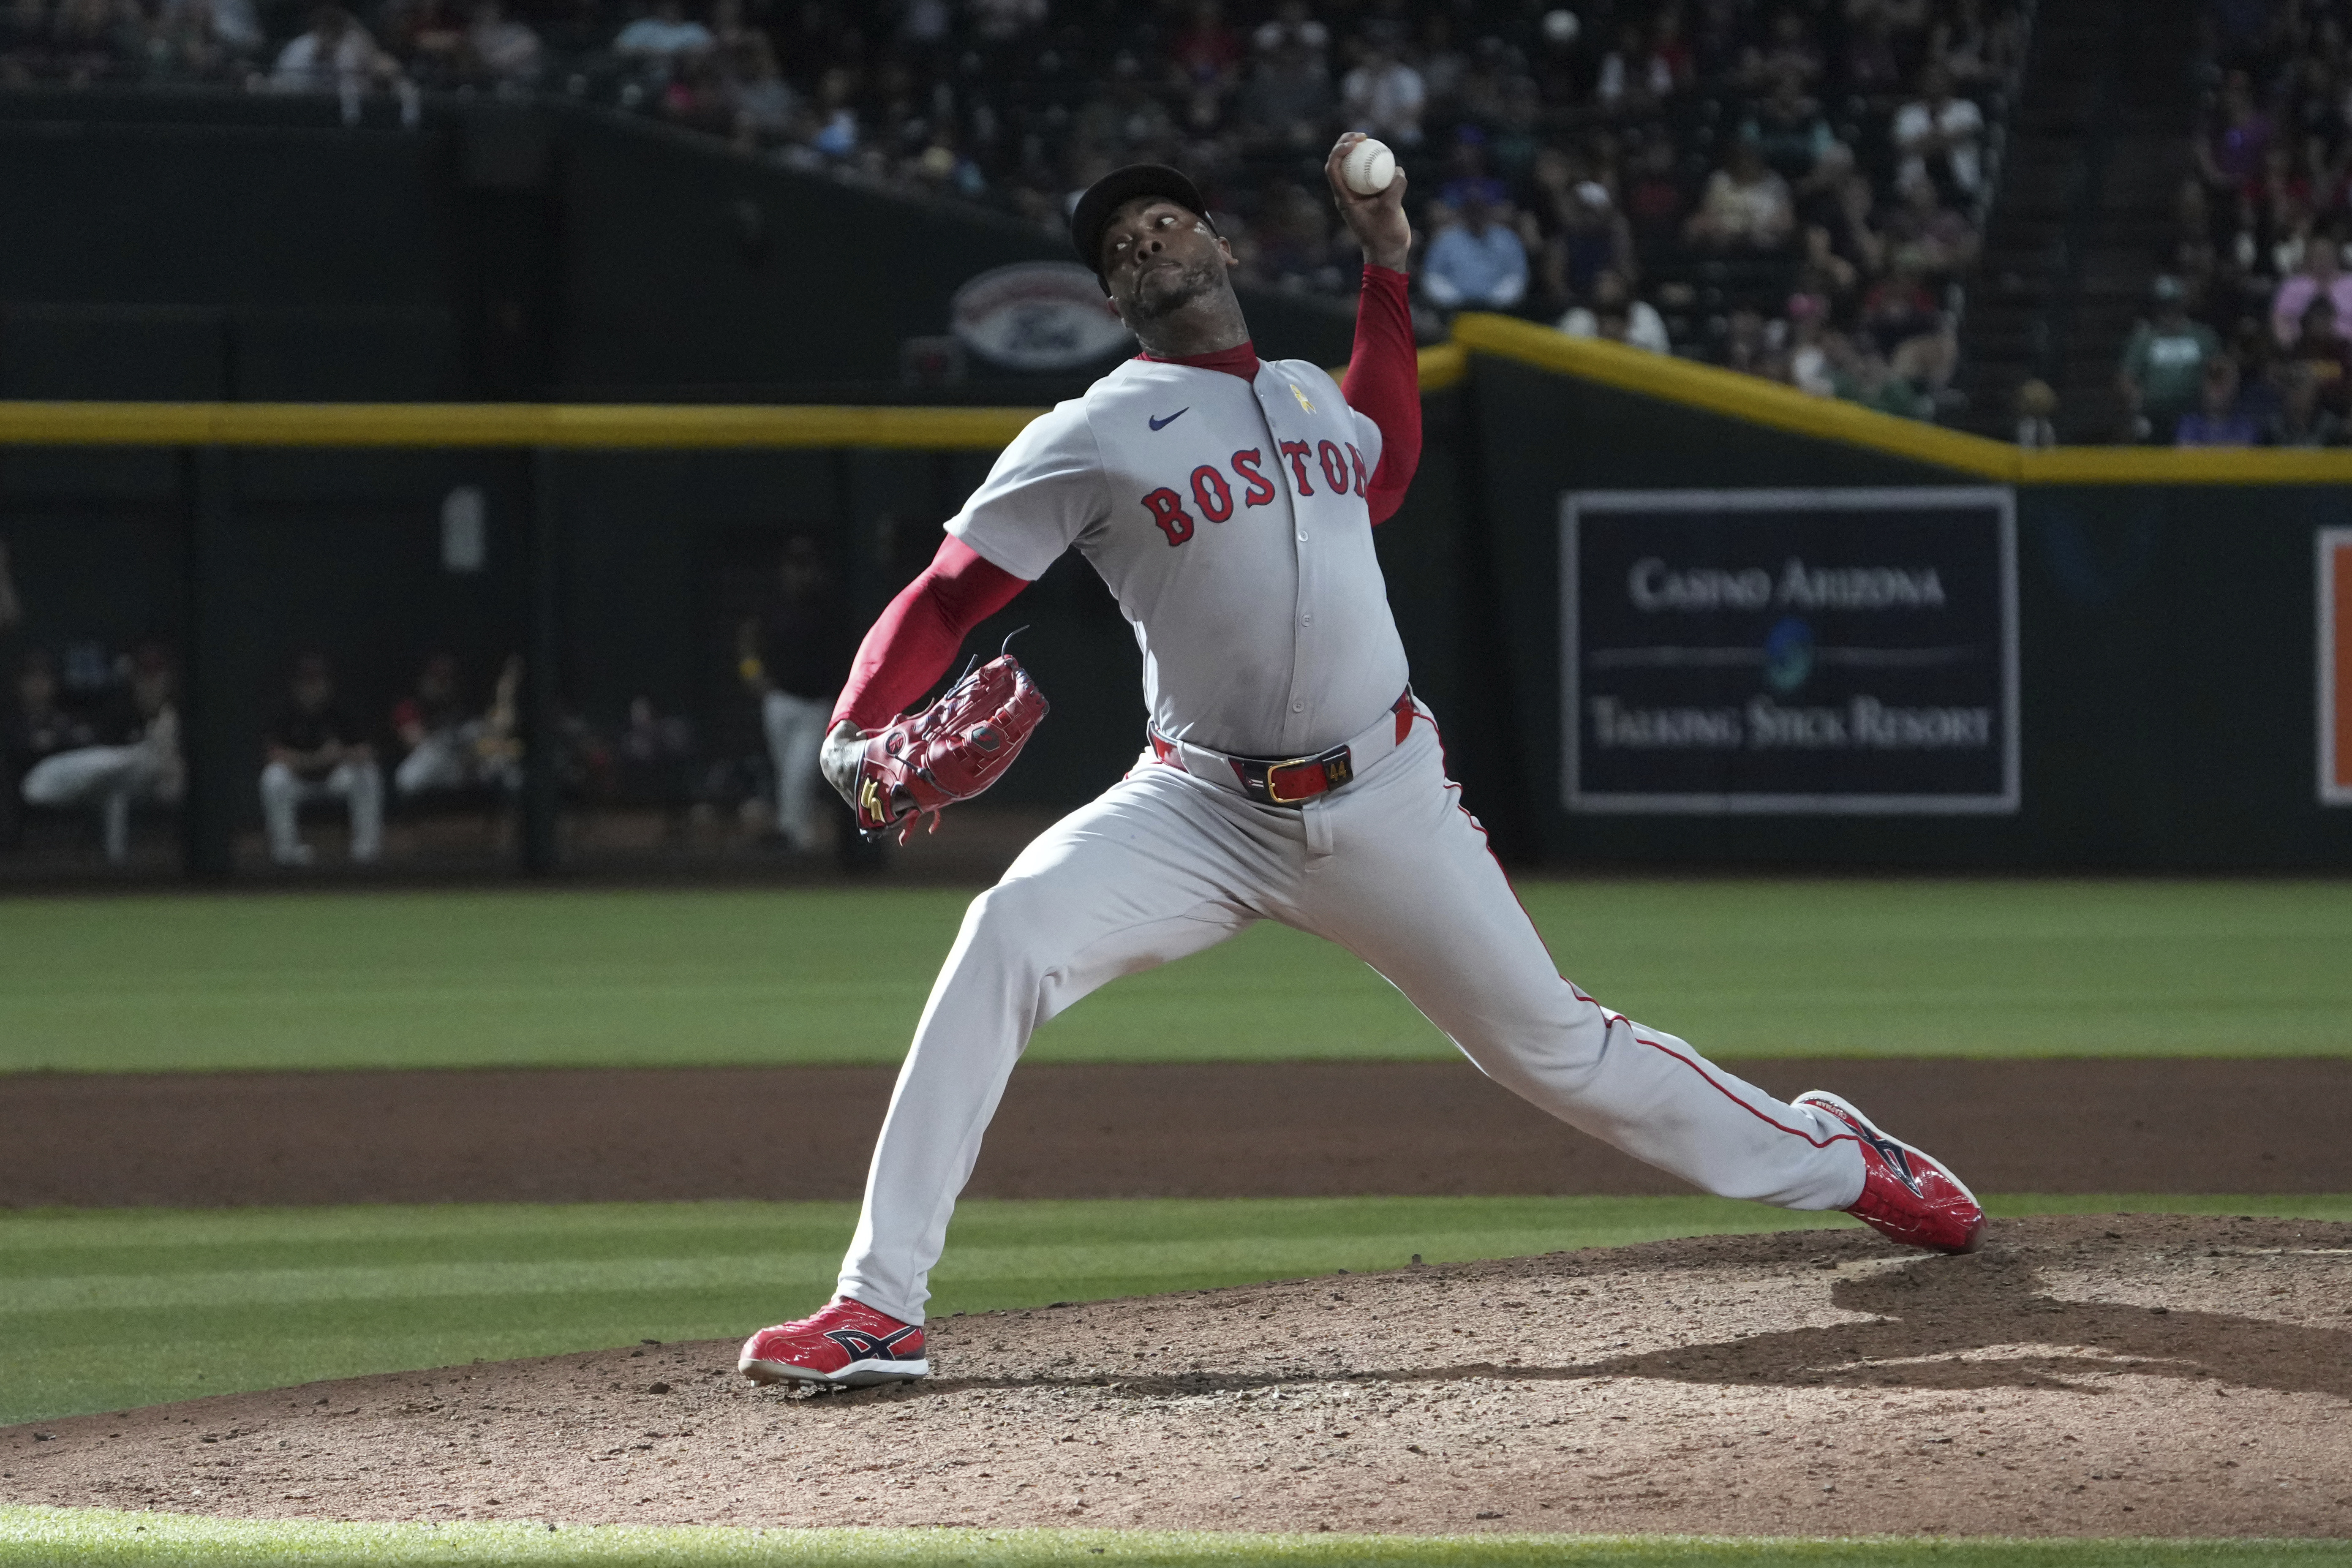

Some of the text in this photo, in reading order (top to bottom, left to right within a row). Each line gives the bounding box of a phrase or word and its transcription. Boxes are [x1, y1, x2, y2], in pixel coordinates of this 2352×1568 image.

[1141, 438, 1368, 547] BOSTON
[1331, 761, 1346, 781] 44
[1816, 1101, 1847, 1119] CHAPMAN
